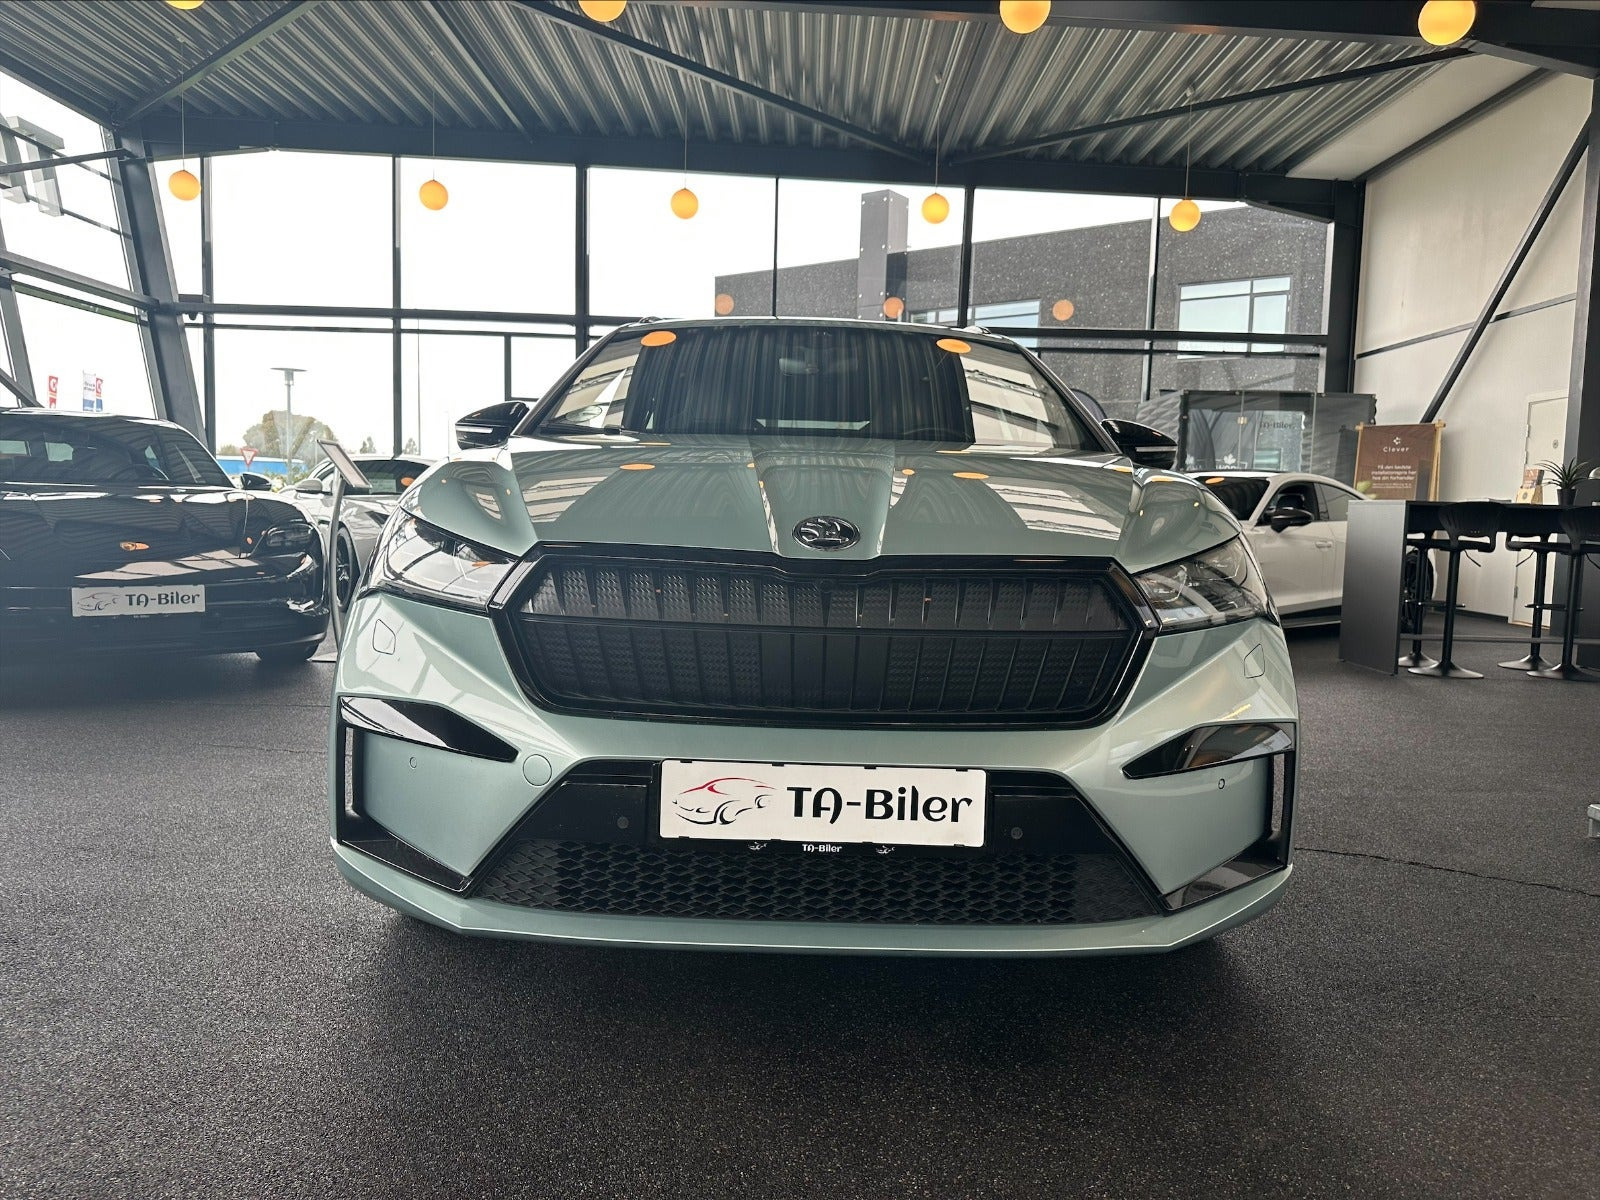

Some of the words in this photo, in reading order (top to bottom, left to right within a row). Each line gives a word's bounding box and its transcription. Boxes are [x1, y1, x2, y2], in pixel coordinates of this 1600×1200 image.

[125, 591, 200, 608] TA-Biler
[786, 785, 973, 825] TA-Biler
[801, 843, 843, 853] TA-Biler
